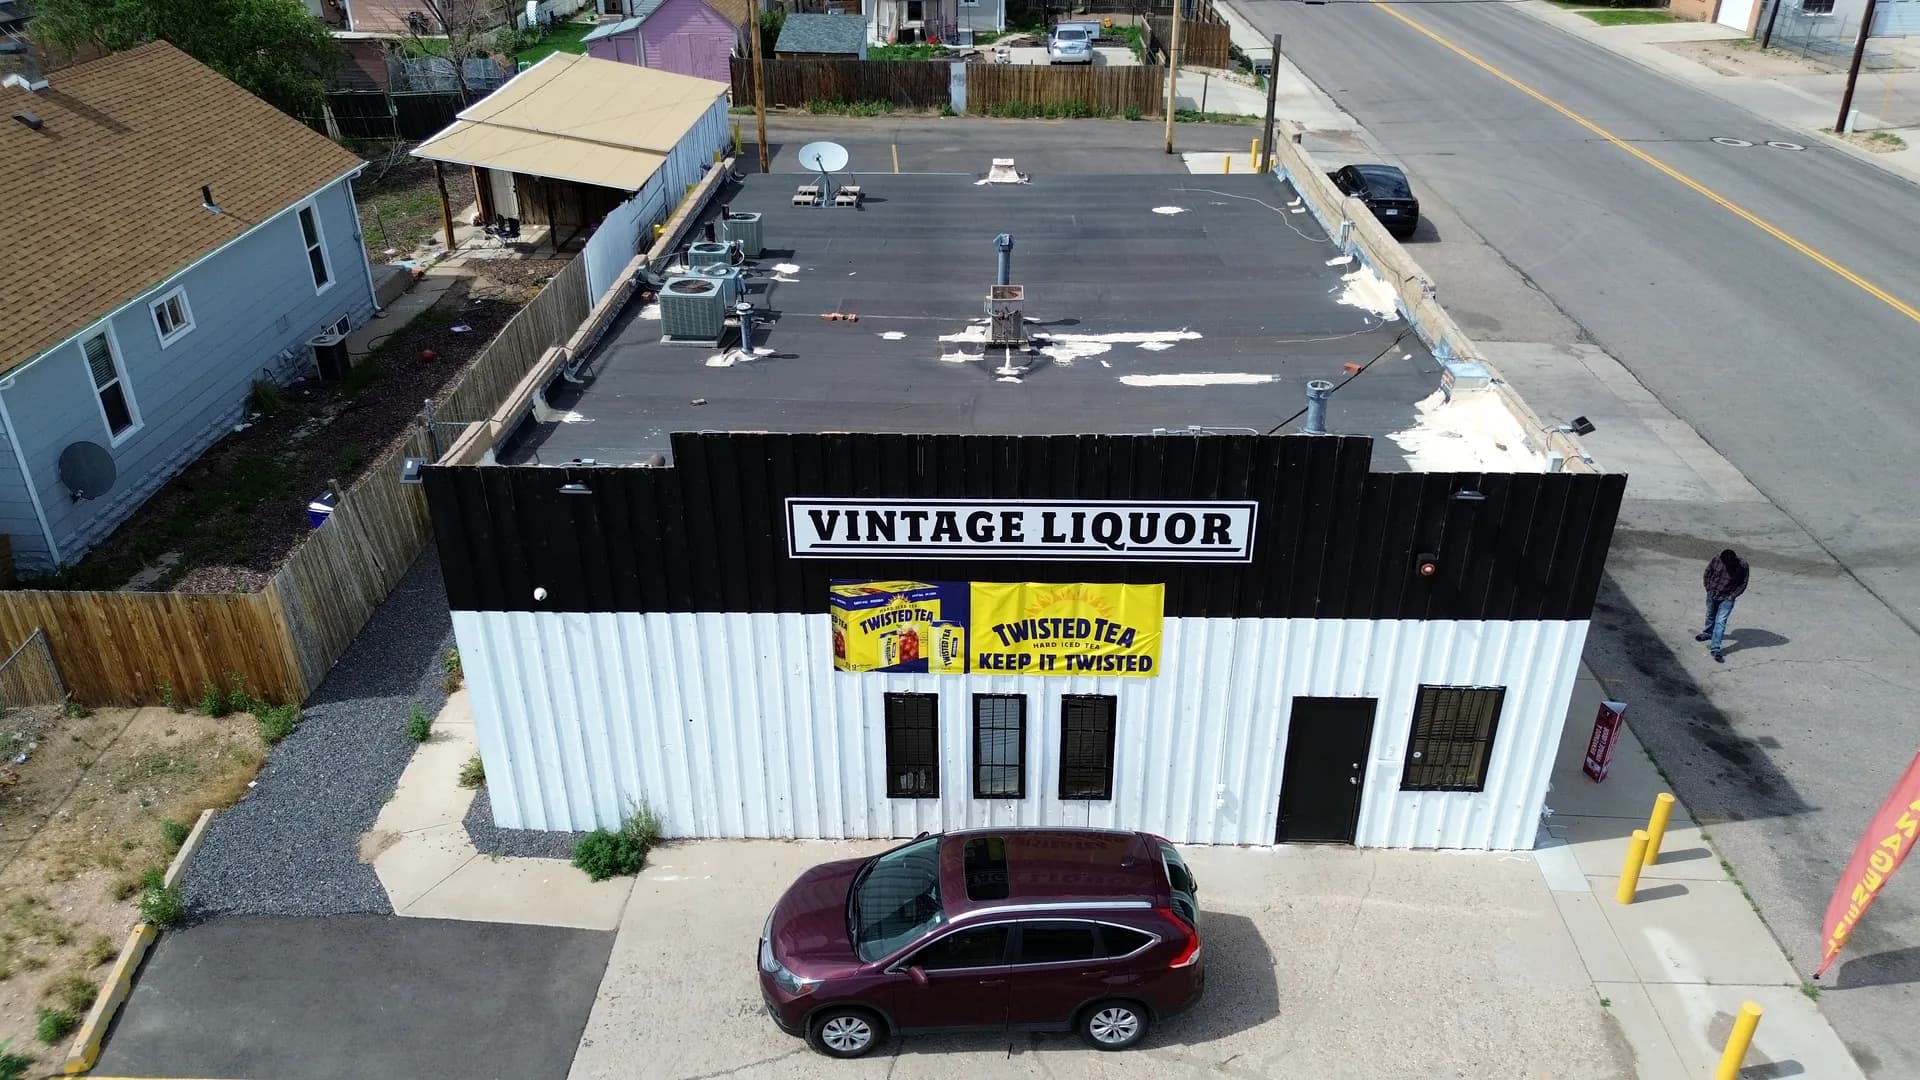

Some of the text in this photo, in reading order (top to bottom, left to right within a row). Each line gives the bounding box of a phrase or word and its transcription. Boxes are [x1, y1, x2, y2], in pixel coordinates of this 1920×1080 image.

[808, 510, 1232, 551] VINTAGE LIQUOR
[859, 609, 912, 634] TWISTED
[915, 608, 933, 624] TEA
[992, 618, 1091, 647] TWISTED
[1094, 618, 1137, 649] TEA
[1033, 641, 1057, 649] HARD
[979, 653, 1153, 672] KEEP IT TWISTED
